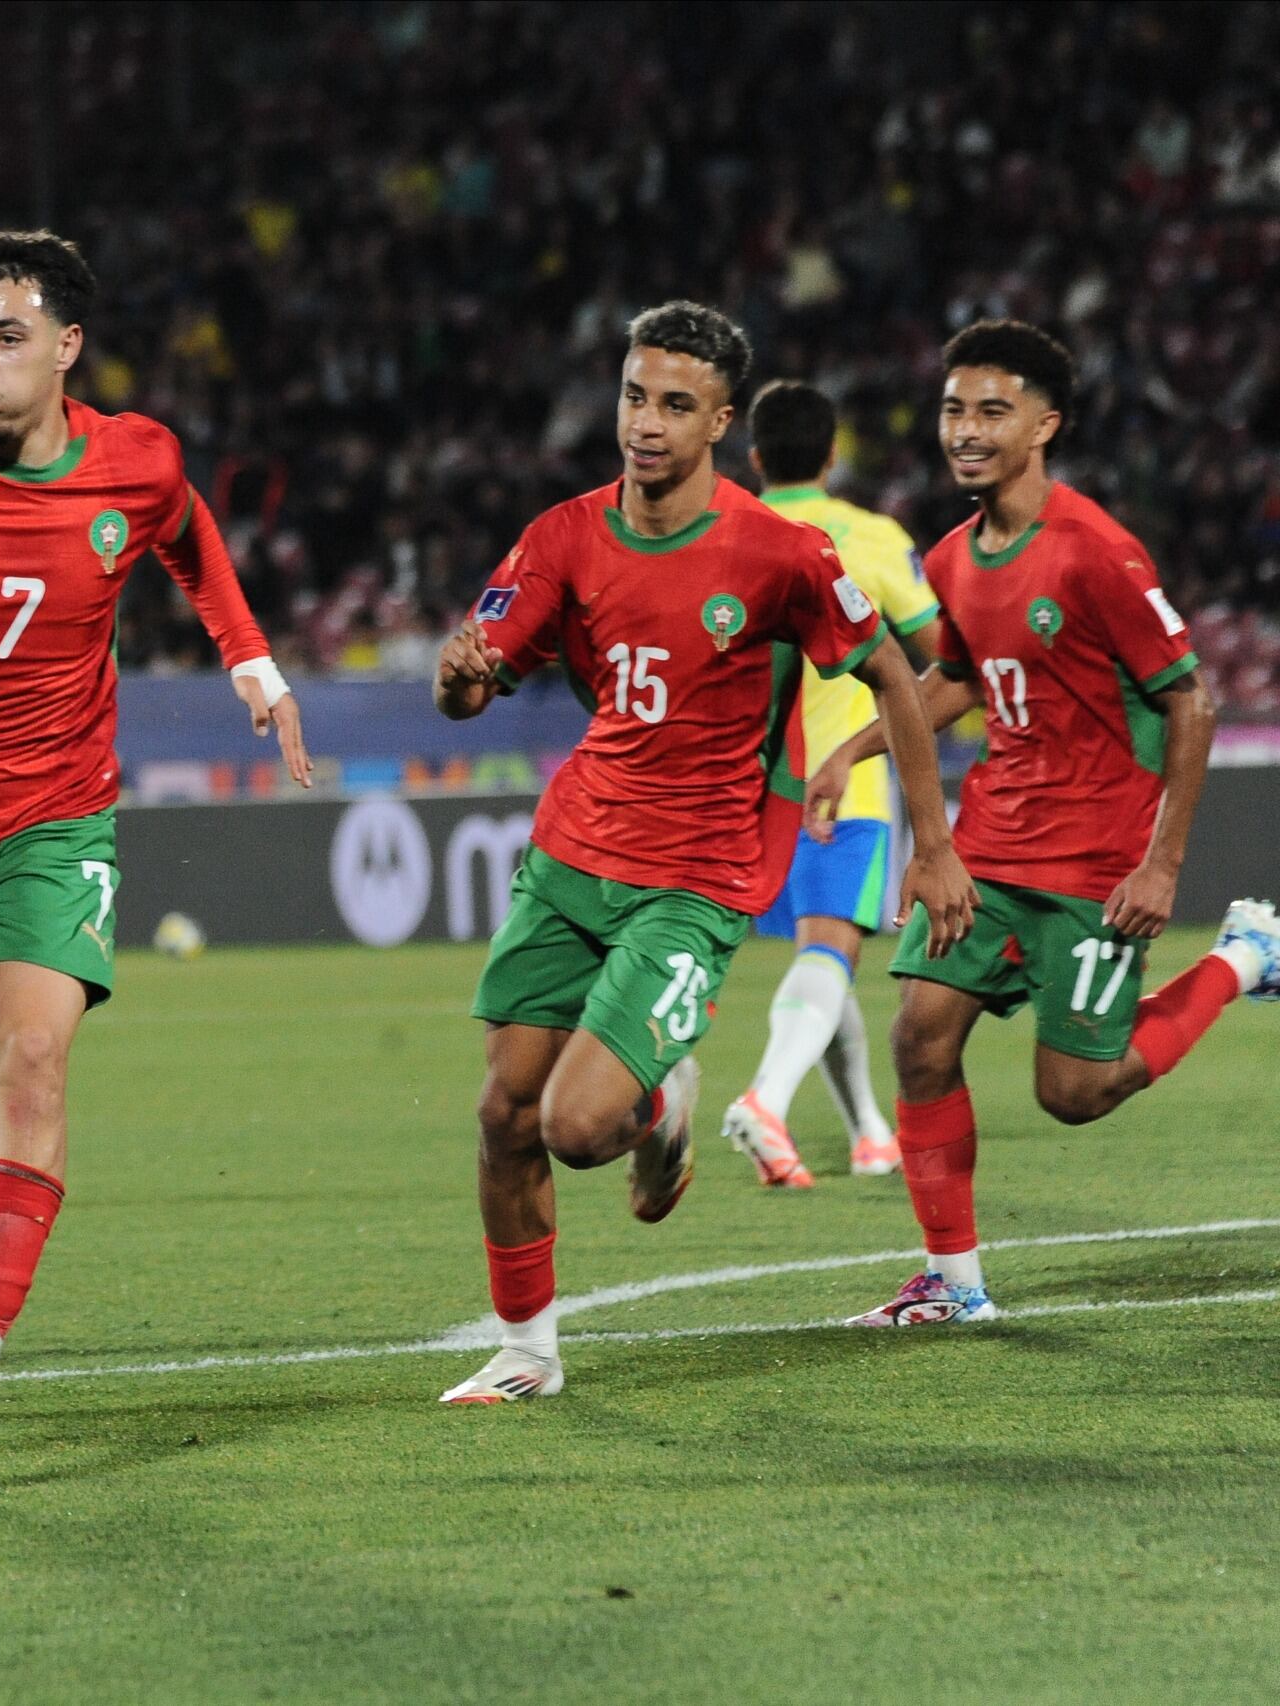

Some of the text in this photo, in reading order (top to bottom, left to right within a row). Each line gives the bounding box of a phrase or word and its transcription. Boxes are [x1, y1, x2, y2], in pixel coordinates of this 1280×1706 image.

[606, 642, 671, 724] 15
[981, 657, 1029, 728] 17
[81, 860, 114, 931] 7
[651, 952, 709, 1042] 15
[1070, 937, 1135, 1015] 17
